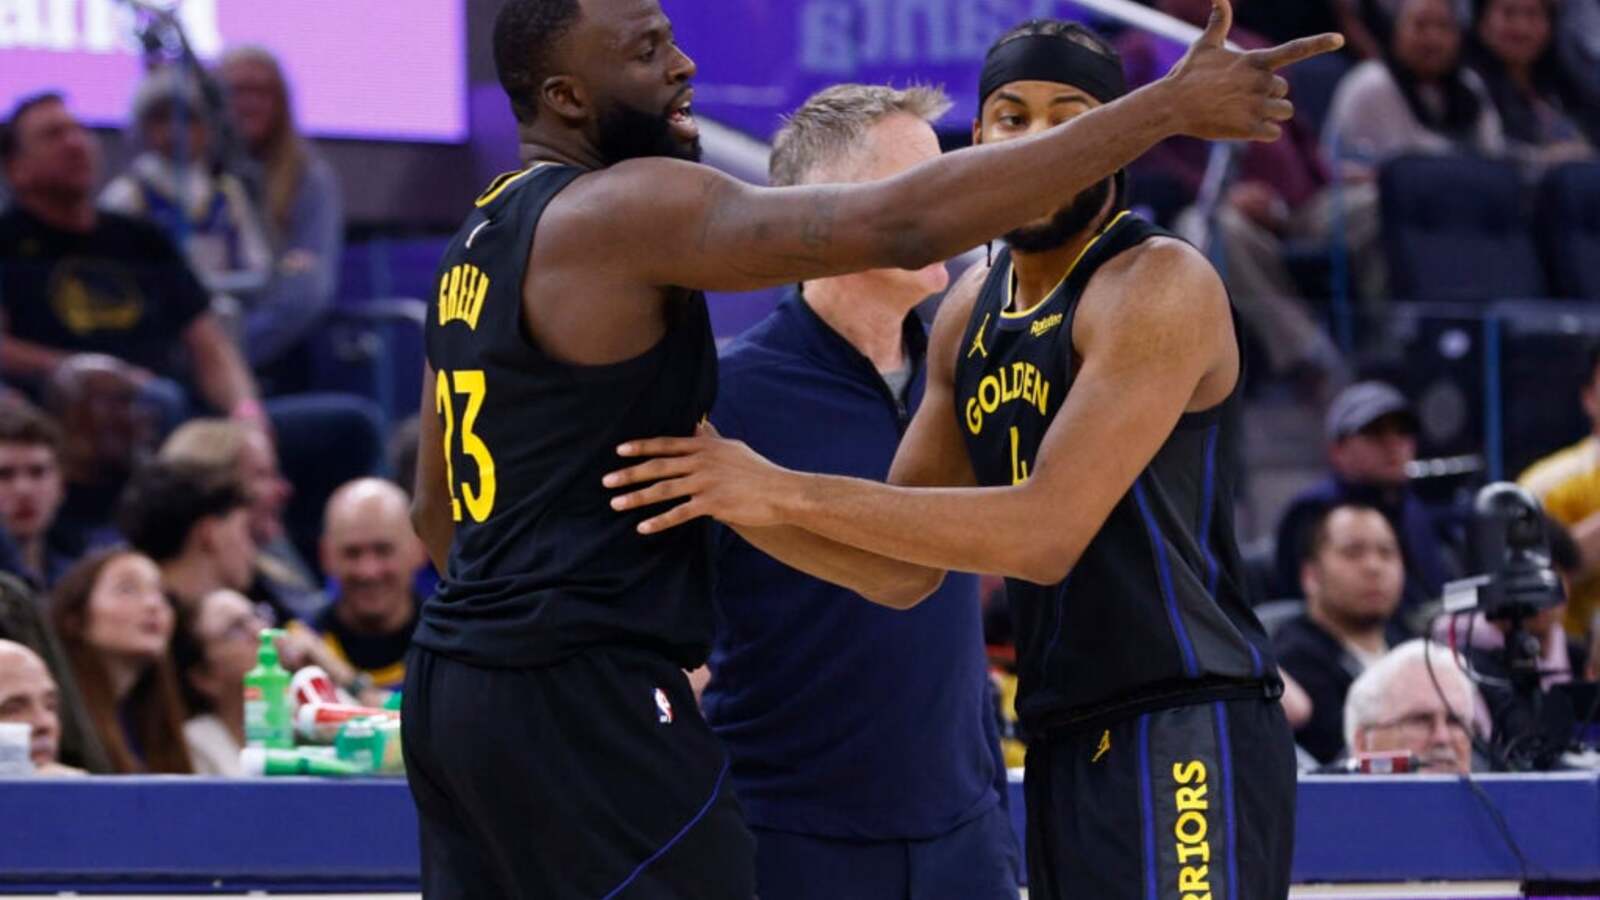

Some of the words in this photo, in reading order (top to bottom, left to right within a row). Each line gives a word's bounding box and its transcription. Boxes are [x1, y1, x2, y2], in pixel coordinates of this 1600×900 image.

[438, 263, 490, 331] GREEN
[966, 361, 1050, 435] GOLDEN
[436, 369, 496, 522] 23
